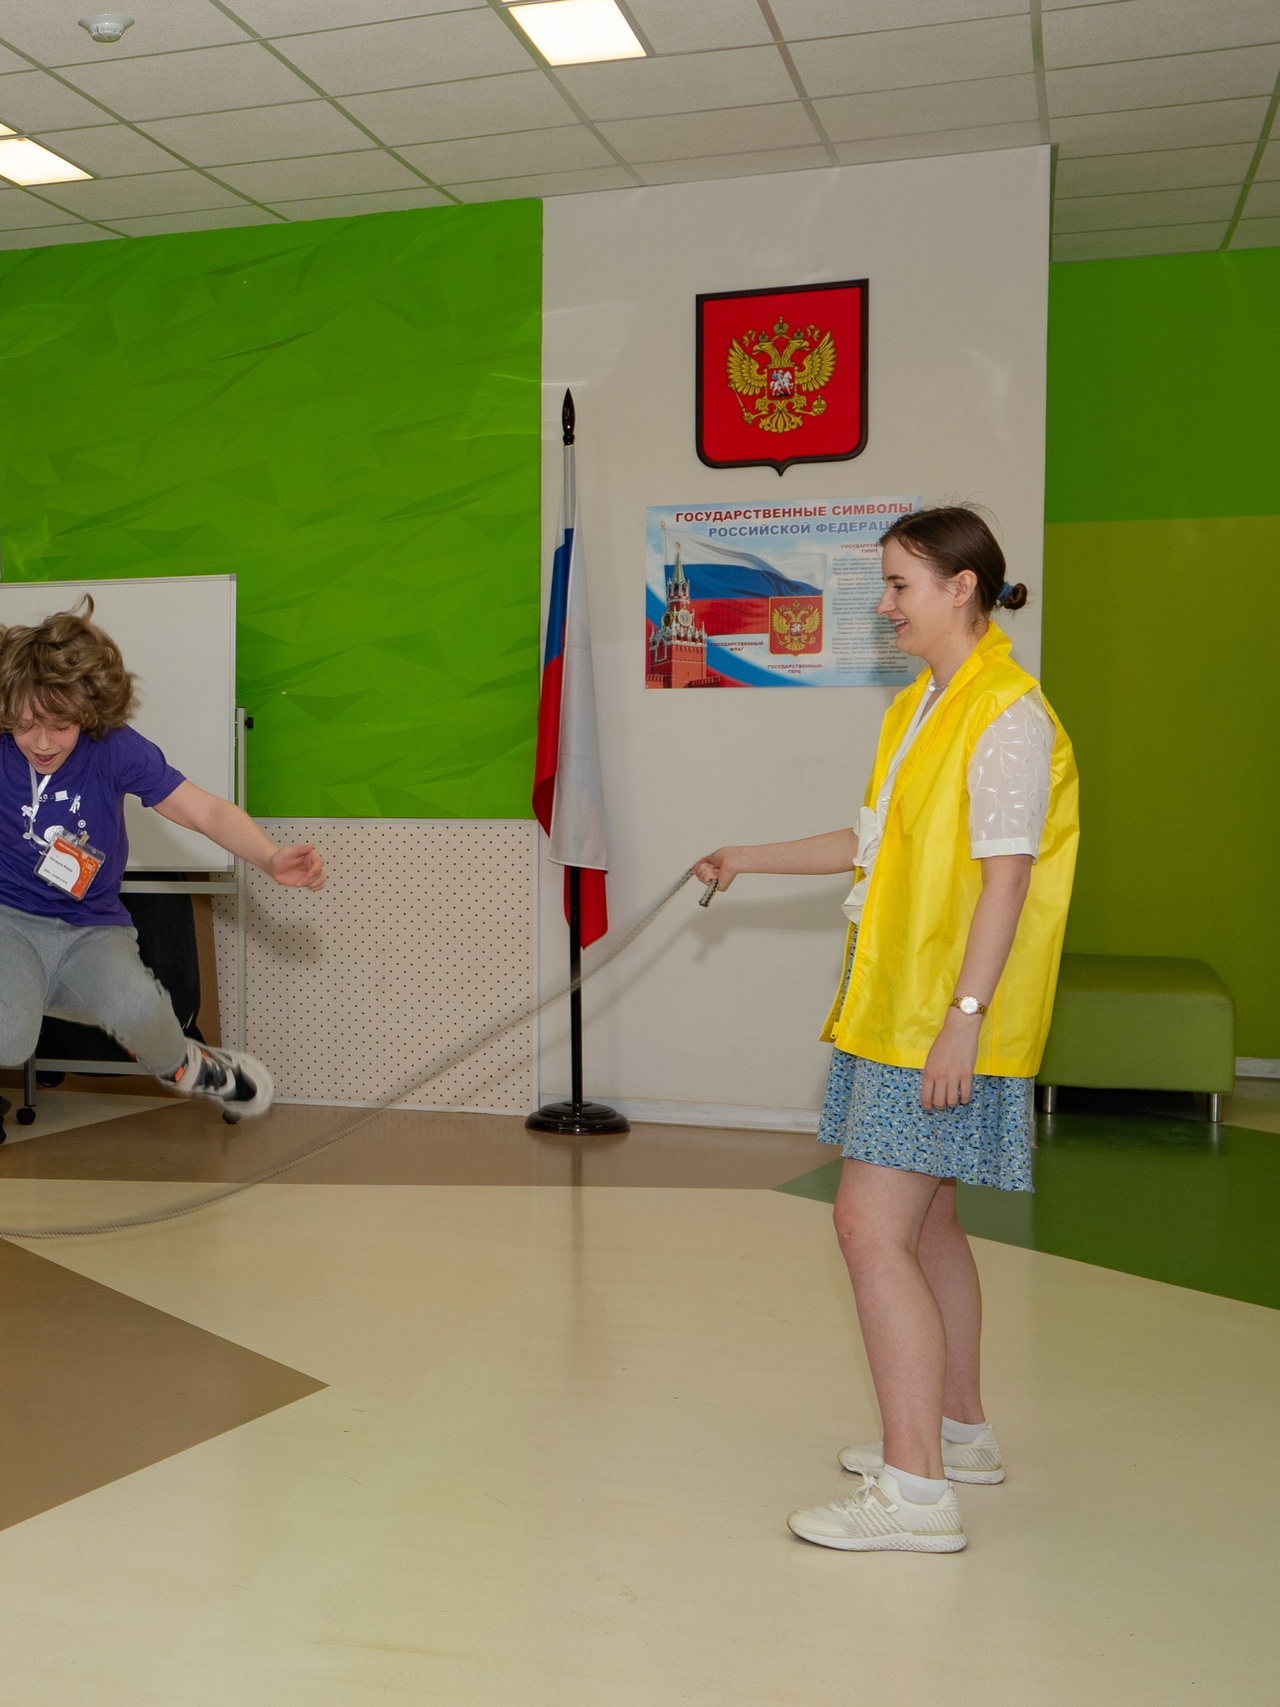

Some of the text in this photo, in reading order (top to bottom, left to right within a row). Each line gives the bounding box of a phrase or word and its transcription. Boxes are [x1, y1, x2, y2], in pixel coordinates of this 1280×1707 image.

[675, 502, 913, 523] ГОСУДАРСТВЕННЫЕ СИМВОЛЫ
[709, 519, 895, 537] РОССИЙСКОЙ ФЕДЕРАЦ
